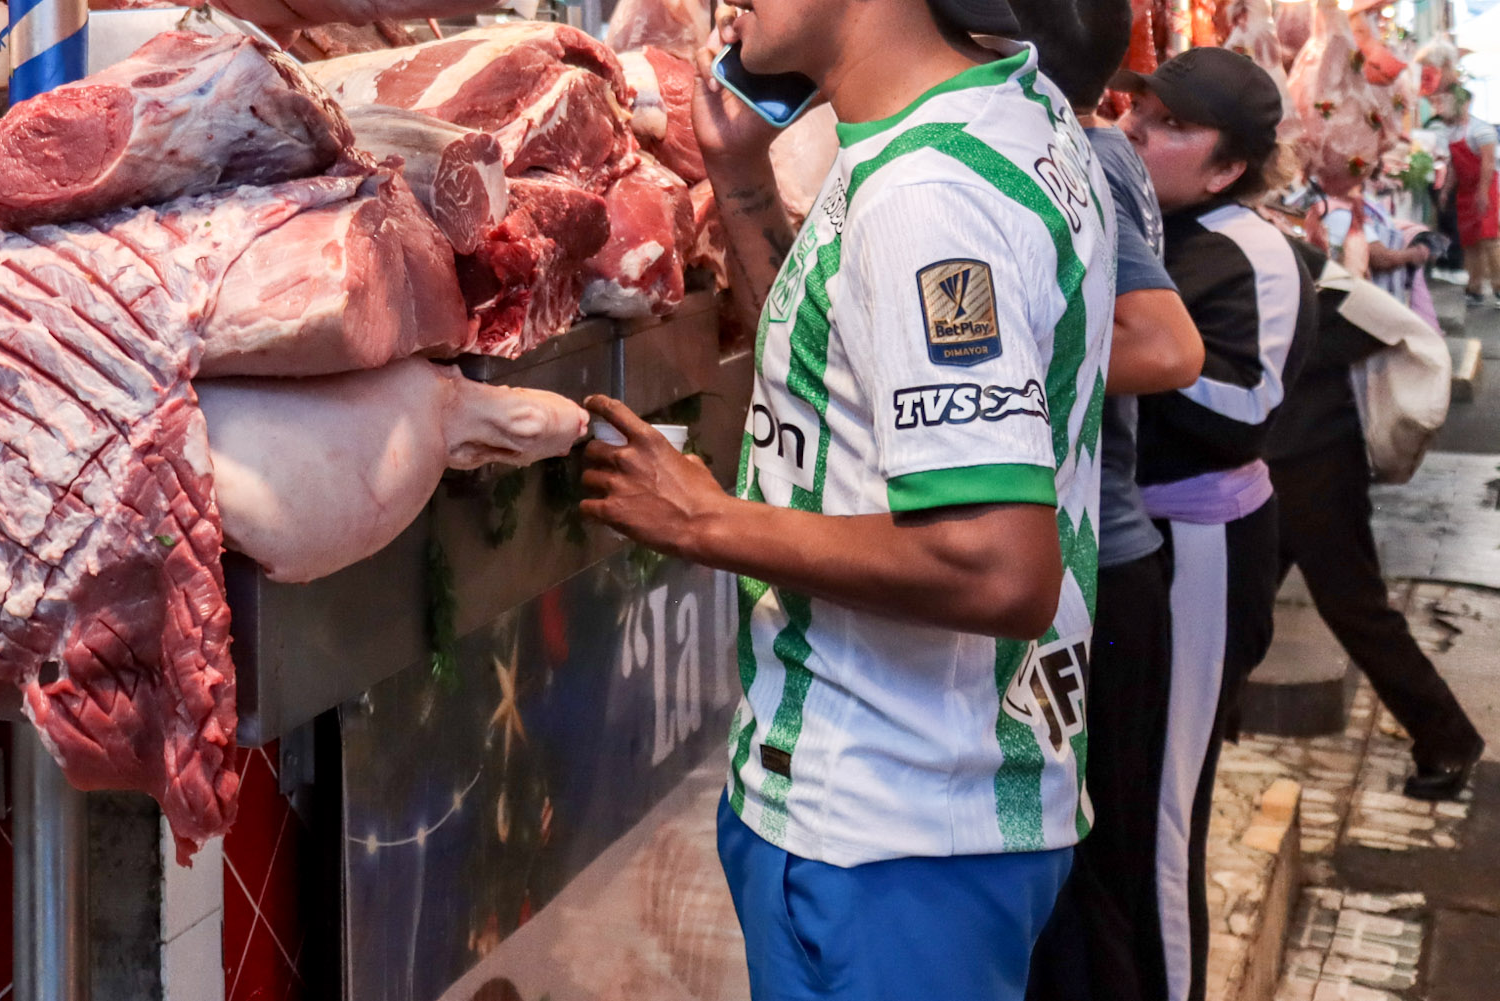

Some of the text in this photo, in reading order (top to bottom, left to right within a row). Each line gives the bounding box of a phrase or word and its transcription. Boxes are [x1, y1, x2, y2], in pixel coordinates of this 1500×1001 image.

[934, 321, 989, 338] BetPlay
[943, 345, 989, 358] DIMAYOR
[894, 383, 981, 430] TVS
